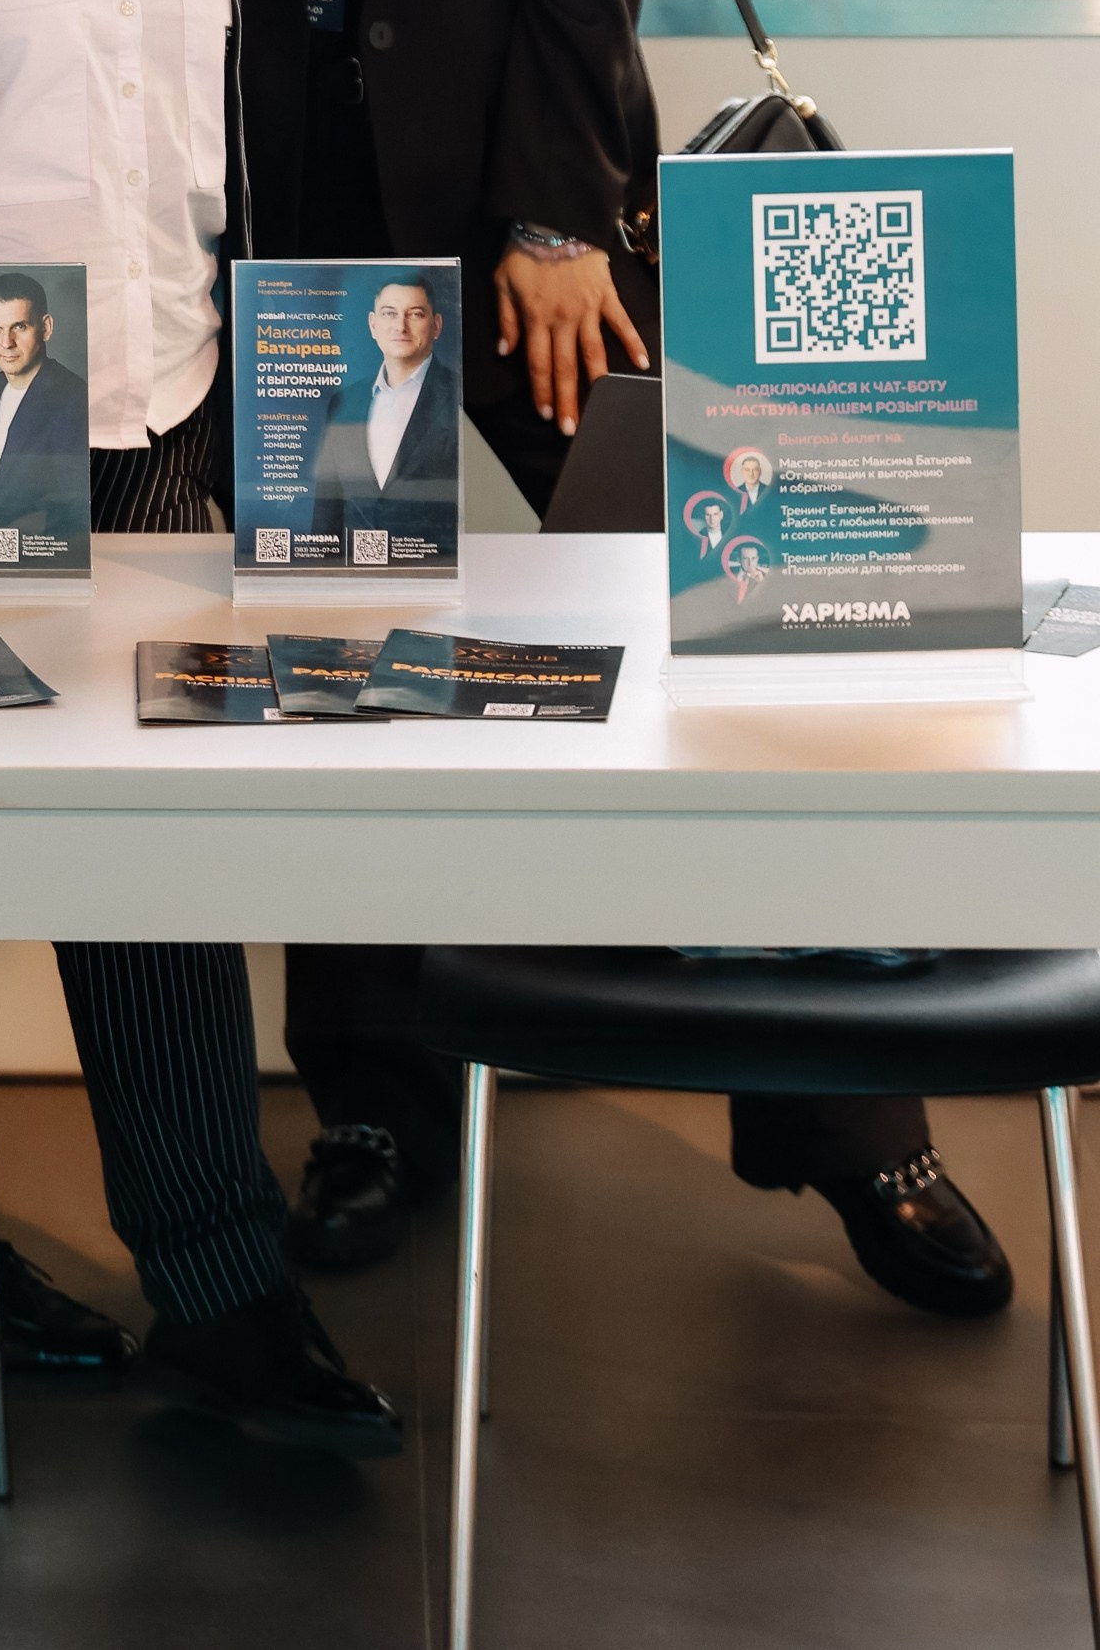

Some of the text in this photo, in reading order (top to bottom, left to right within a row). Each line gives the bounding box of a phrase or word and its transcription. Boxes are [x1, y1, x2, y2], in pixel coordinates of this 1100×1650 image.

[257, 312, 344, 321] НОВЫЙ МАСТЕР-КЛАСС
[257, 325, 332, 339] Максима
[256, 340, 342, 358] Батырева
[256, 363, 348, 374] ОТ МОТИВАЦИИ
[256, 376, 342, 386] К ВЫГОРАНИЮ
[256, 388, 321, 398] И ОБРАТНО
[736, 380, 947, 397] ПОДКЛЮЧАЙСЯ К ЧАТ-БОТУ
[706, 399, 978, 417] И УЧАСТВУЙ В НАШЕМ РОЗЫГРЫШЕ!
[257, 412, 291, 421] УЗНАЙТЕ
[263, 424, 308, 432] сохранить
[778, 432, 838, 446] Выиграй
[842, 431, 880, 444] билет
[263, 442, 302, 450] команды
[275, 454, 304, 462] терять
[780, 454, 972, 470] Мастер-класс Максима Батырева
[263, 472, 298, 480] игроков
[780, 470, 802, 481] «От
[804, 470, 866, 481] мотивации
[878, 469, 944, 480] выгоранию
[275, 486, 309, 494] сгореть
[780, 482, 844, 495] и обратно»
[263, 494, 295, 502] самому
[781, 503, 930, 518] Тренинг Евгения Жигилия
[781, 516, 974, 528] «Работа с любыми возражениями
[294, 534, 340, 544] ХАРИЗМА
[781, 530, 900, 542] и сопротивлениями»
[782, 550, 912, 565] Тренинг Игоря Рызова
[782, 564, 966, 577] «Психотрюки для переговоров»
[782, 600, 911, 622] ХАРИЗМА
[391, 662, 602, 682] РАСПИСАНИЕ
